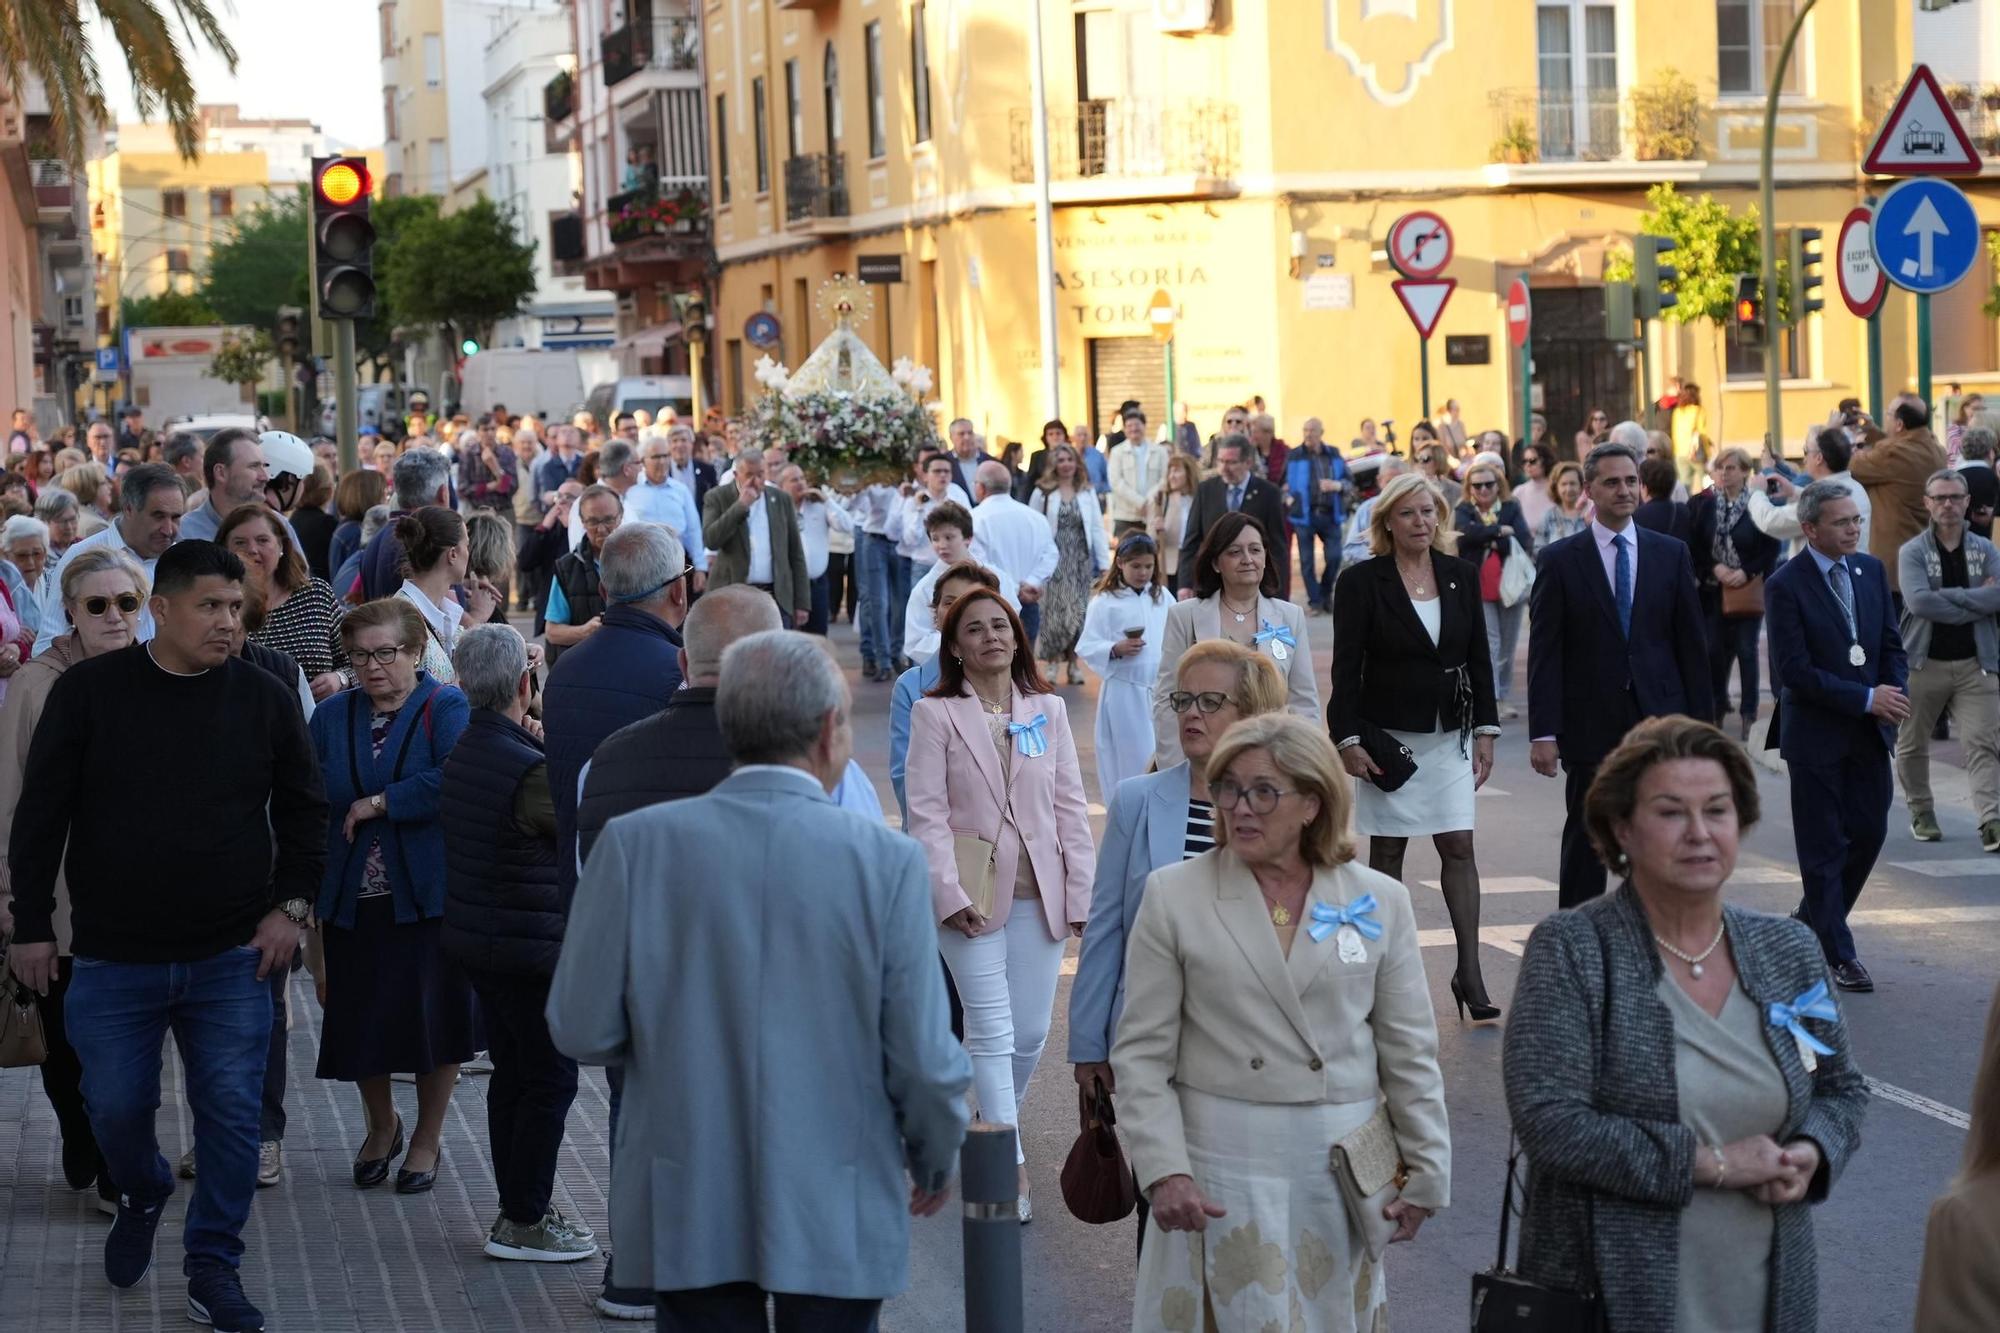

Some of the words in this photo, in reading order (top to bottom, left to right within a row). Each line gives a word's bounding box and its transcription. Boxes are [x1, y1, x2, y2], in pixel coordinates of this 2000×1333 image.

[1847, 249, 1872, 262] EXCEPT
[1853, 263, 1870, 273] TRAM
[100, 349, 113, 368] P
